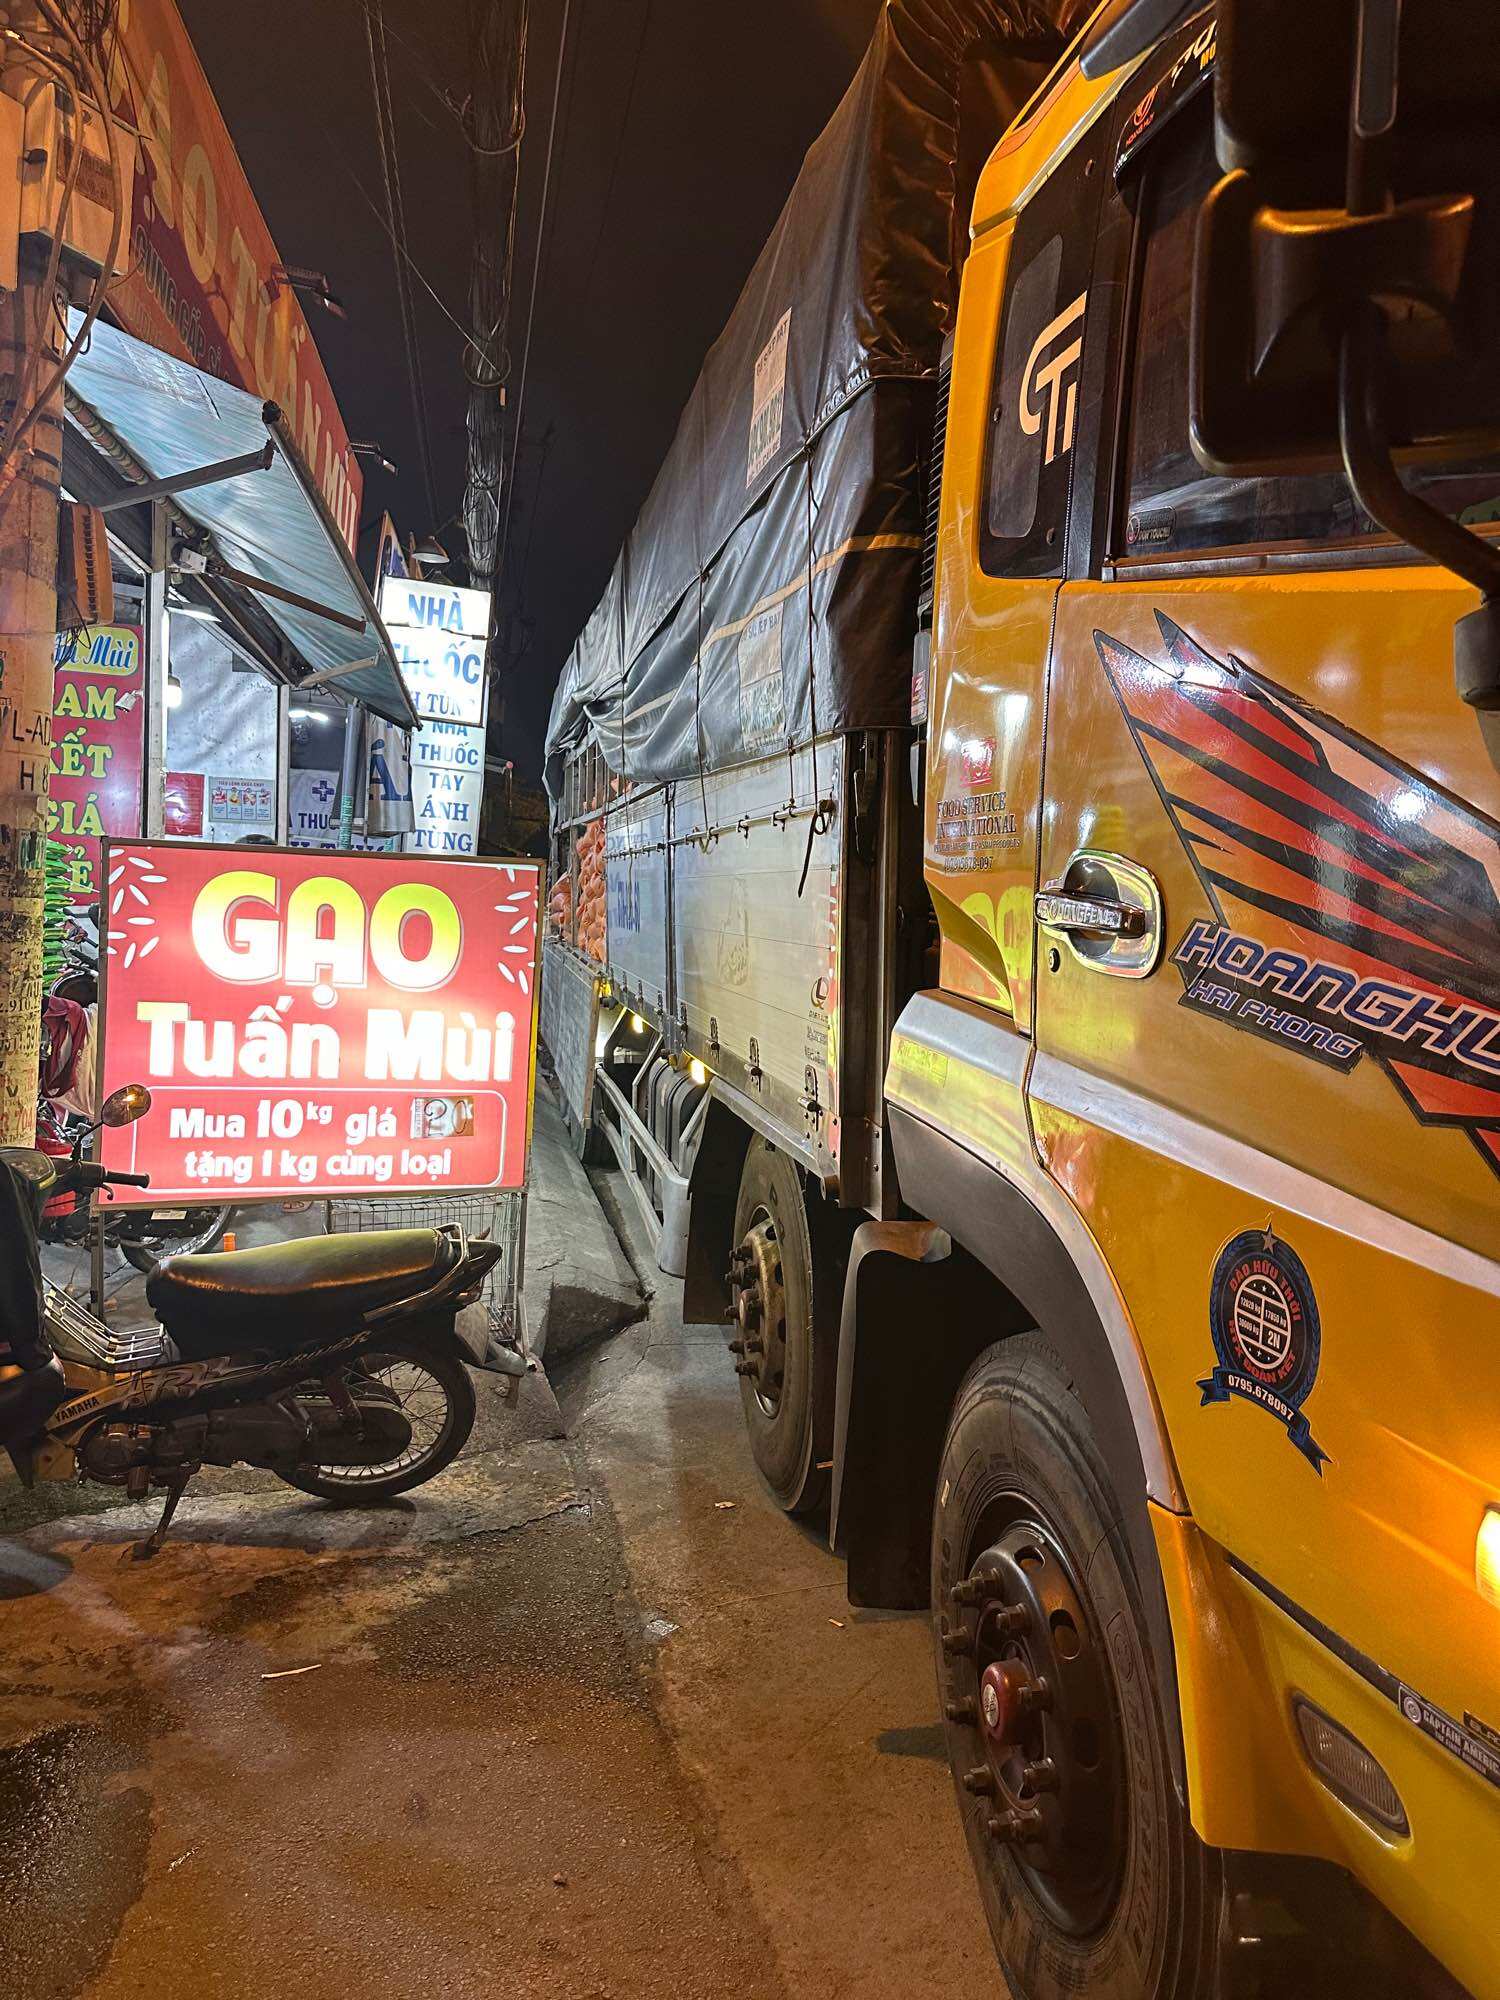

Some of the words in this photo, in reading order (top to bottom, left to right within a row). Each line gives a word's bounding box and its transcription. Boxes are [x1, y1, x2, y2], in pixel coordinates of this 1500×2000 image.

[408, 591, 464, 631] NHÀ
[83, 634, 135, 670] Mùi
[53, 683, 118, 720] AM
[418, 741, 479, 766] THUỐC
[420, 794, 470, 822] ÁNH
[415, 825, 473, 852] TÙNG
[70, 845, 94, 894] Ẻ
[191, 871, 463, 1008] GẠO
[1187, 979, 1239, 1011] HAI
[1238, 998, 1363, 1058] PHONG
[136, 995, 341, 1080] Tuấn
[363, 1008, 515, 1082] Mùi
[169, 1107, 246, 1139] Mua
[345, 1105, 397, 1146] giá
[185, 1150, 254, 1184] tặng
[262, 1149, 273, 1177] 1
[280, 1149, 318, 1183] kg
[326, 1149, 393, 1182] cùng
[400, 1148, 451, 1181] loại
[1267, 1330, 1281, 1349] 2N
[53, 1396, 101, 1423] YAMAHA
[1227, 1374, 1295, 1421] 0795.678097
[1423, 1709, 1462, 1746] CAPTAIN
